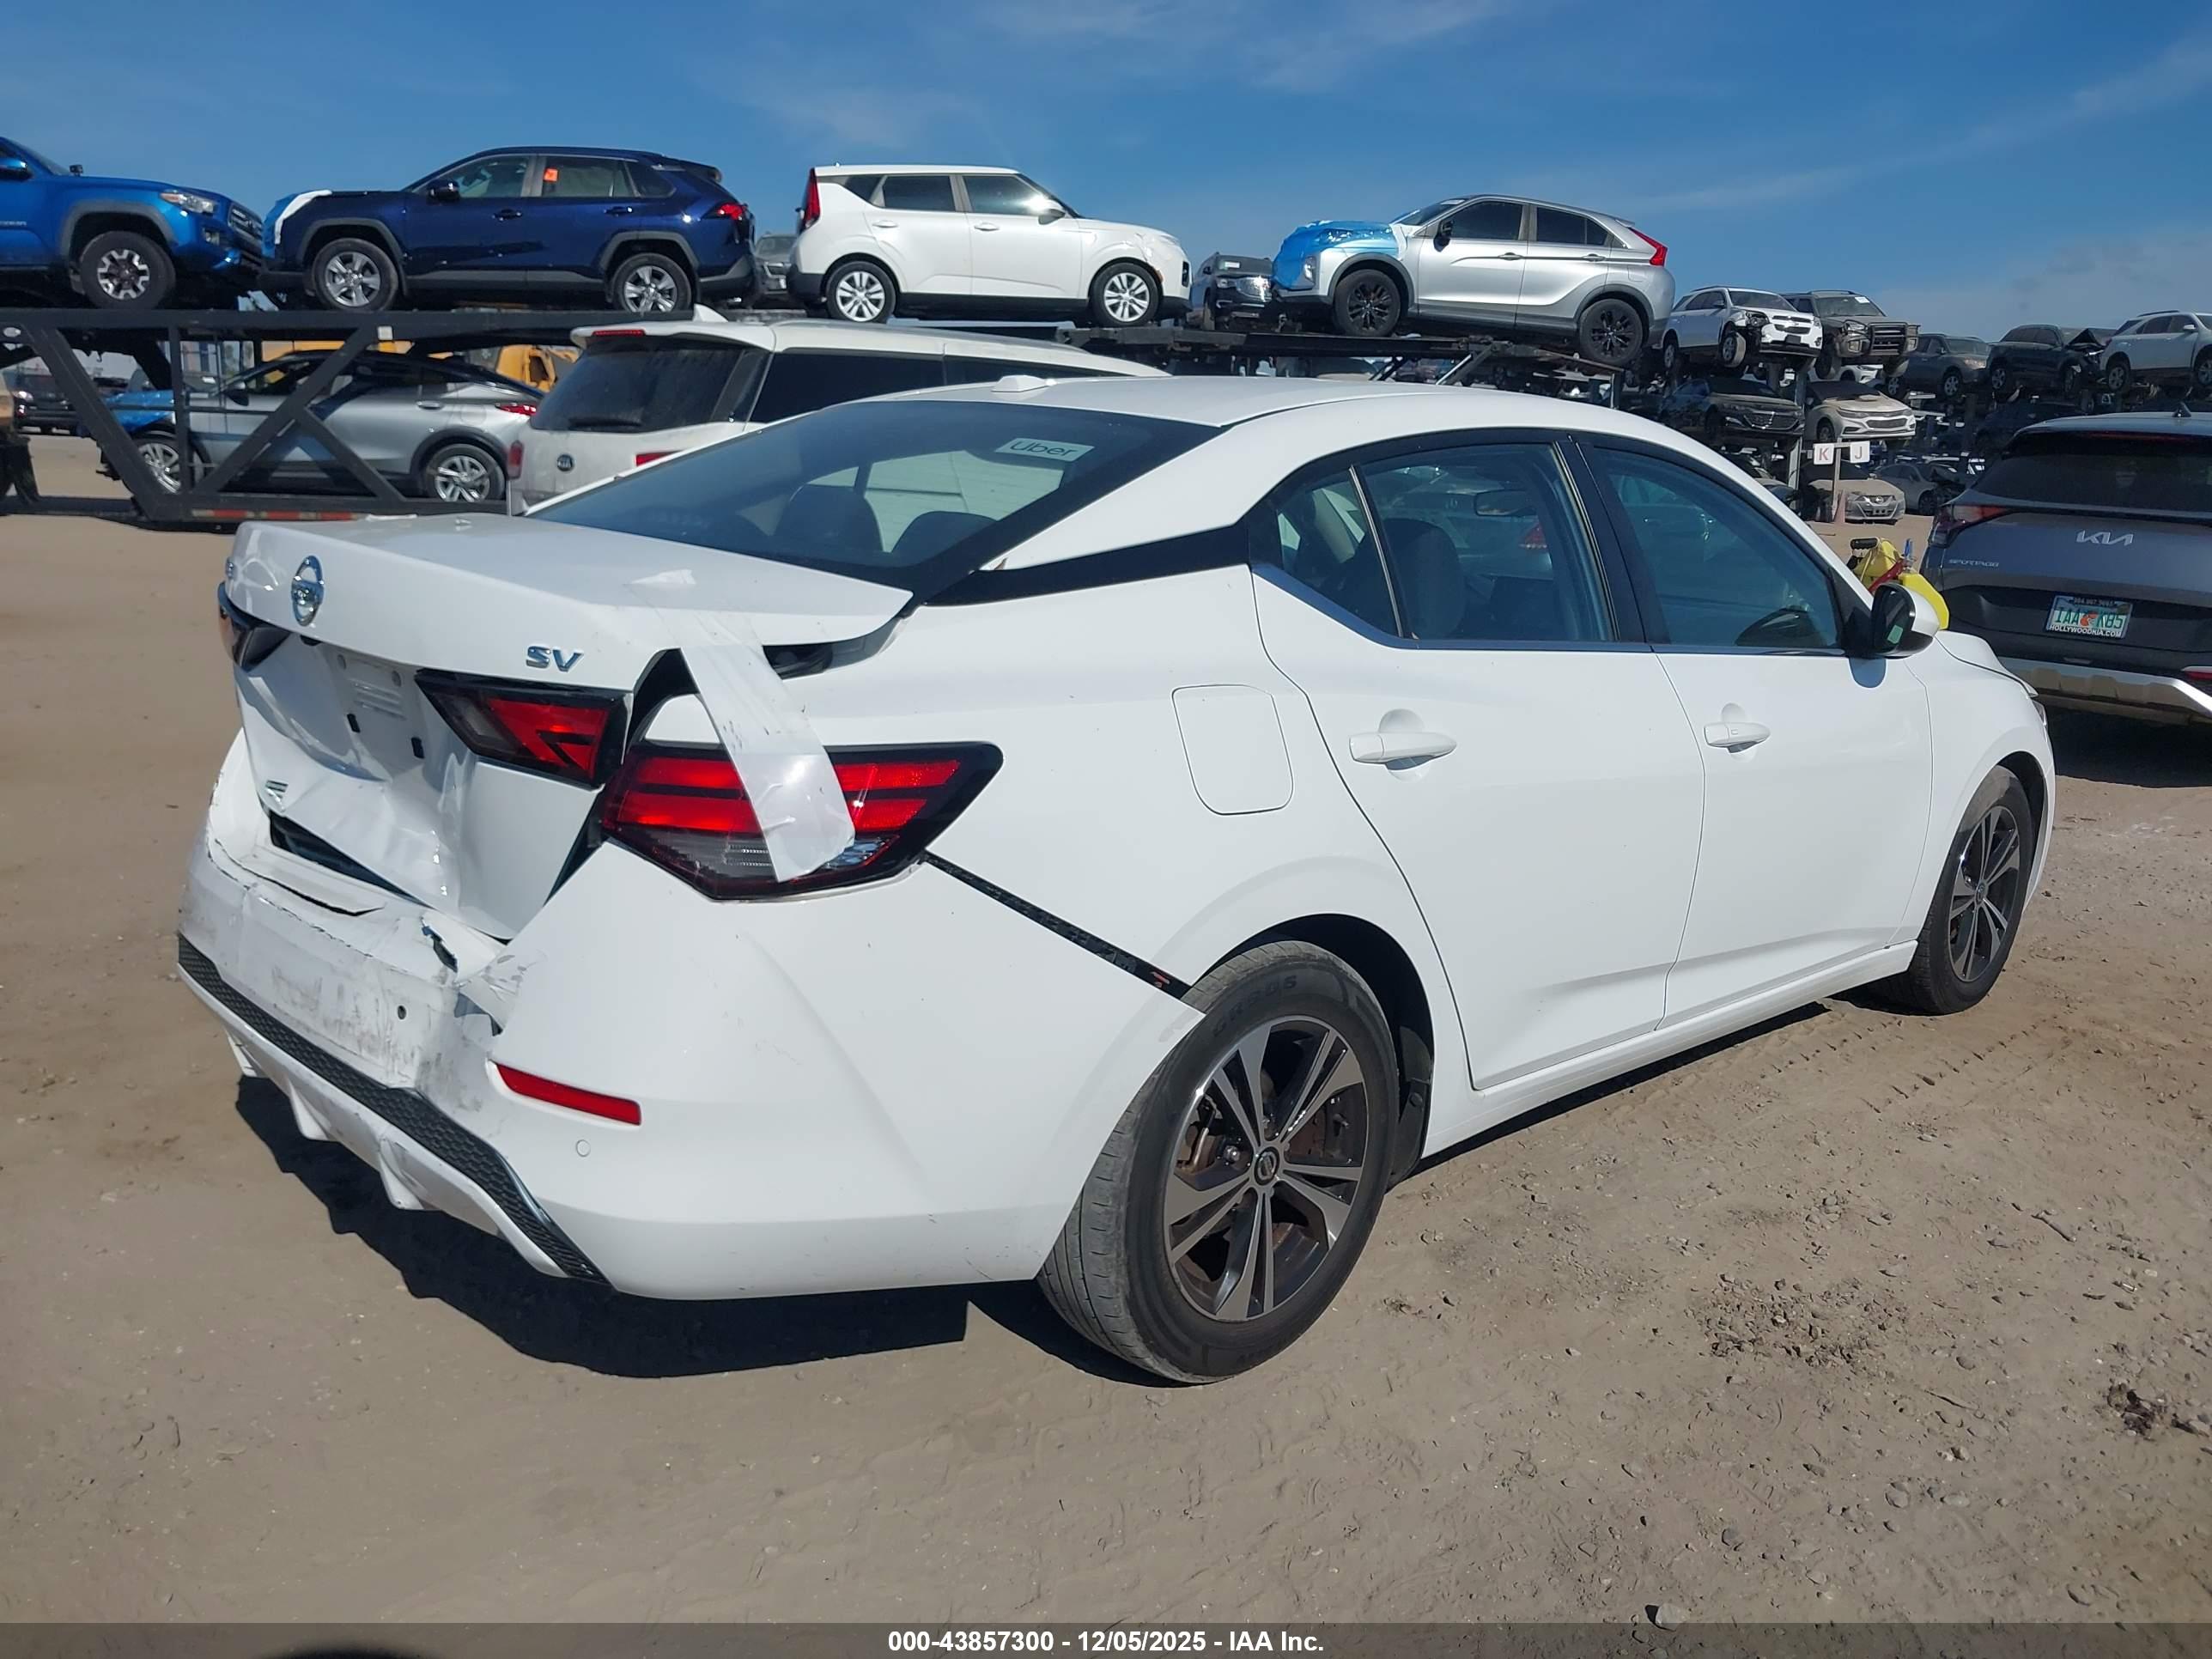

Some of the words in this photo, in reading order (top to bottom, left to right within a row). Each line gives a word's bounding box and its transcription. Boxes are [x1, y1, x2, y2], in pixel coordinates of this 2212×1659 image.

[1010, 441, 1079, 457] Uber
[1819, 447, 1829, 461] K
[1854, 446, 1863, 459] J
[2075, 529, 2134, 546] KIA
[2049, 624, 2122, 638] HOLLYWOODKIA.COM
[526, 646, 584, 672] SV
